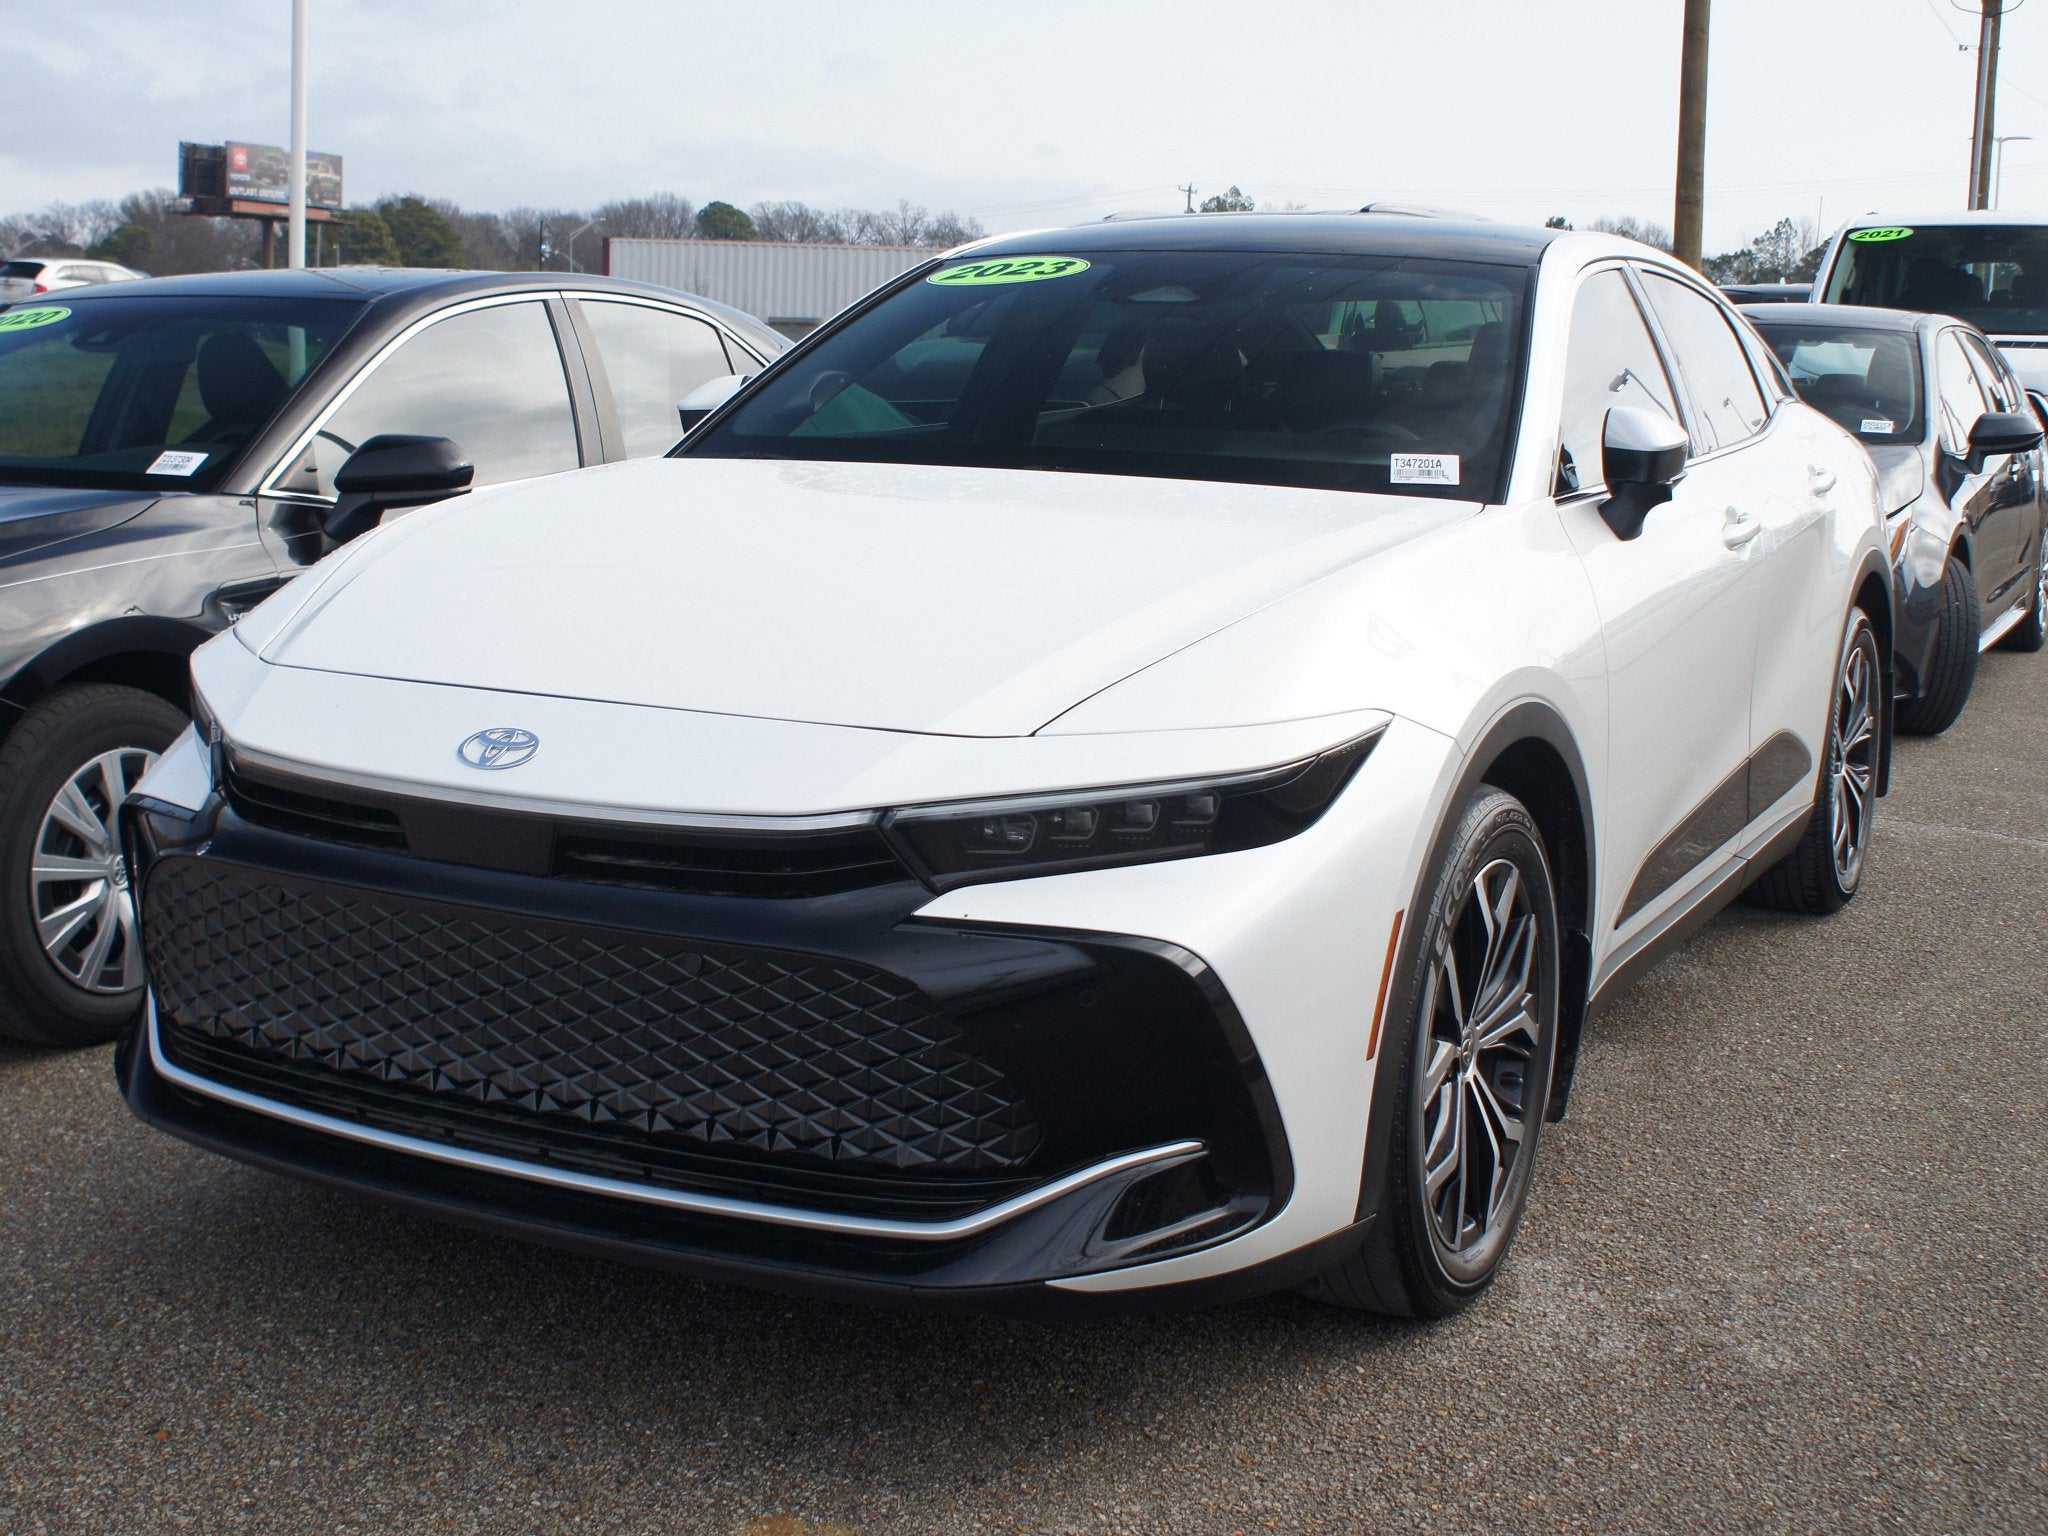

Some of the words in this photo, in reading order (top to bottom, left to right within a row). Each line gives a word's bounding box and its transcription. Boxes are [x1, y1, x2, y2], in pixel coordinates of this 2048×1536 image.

[1855, 229, 1905, 239] 2021
[938, 261, 1077, 281] 2023
[0, 311, 63, 325] 020
[1394, 458, 1442, 469] T347201A
